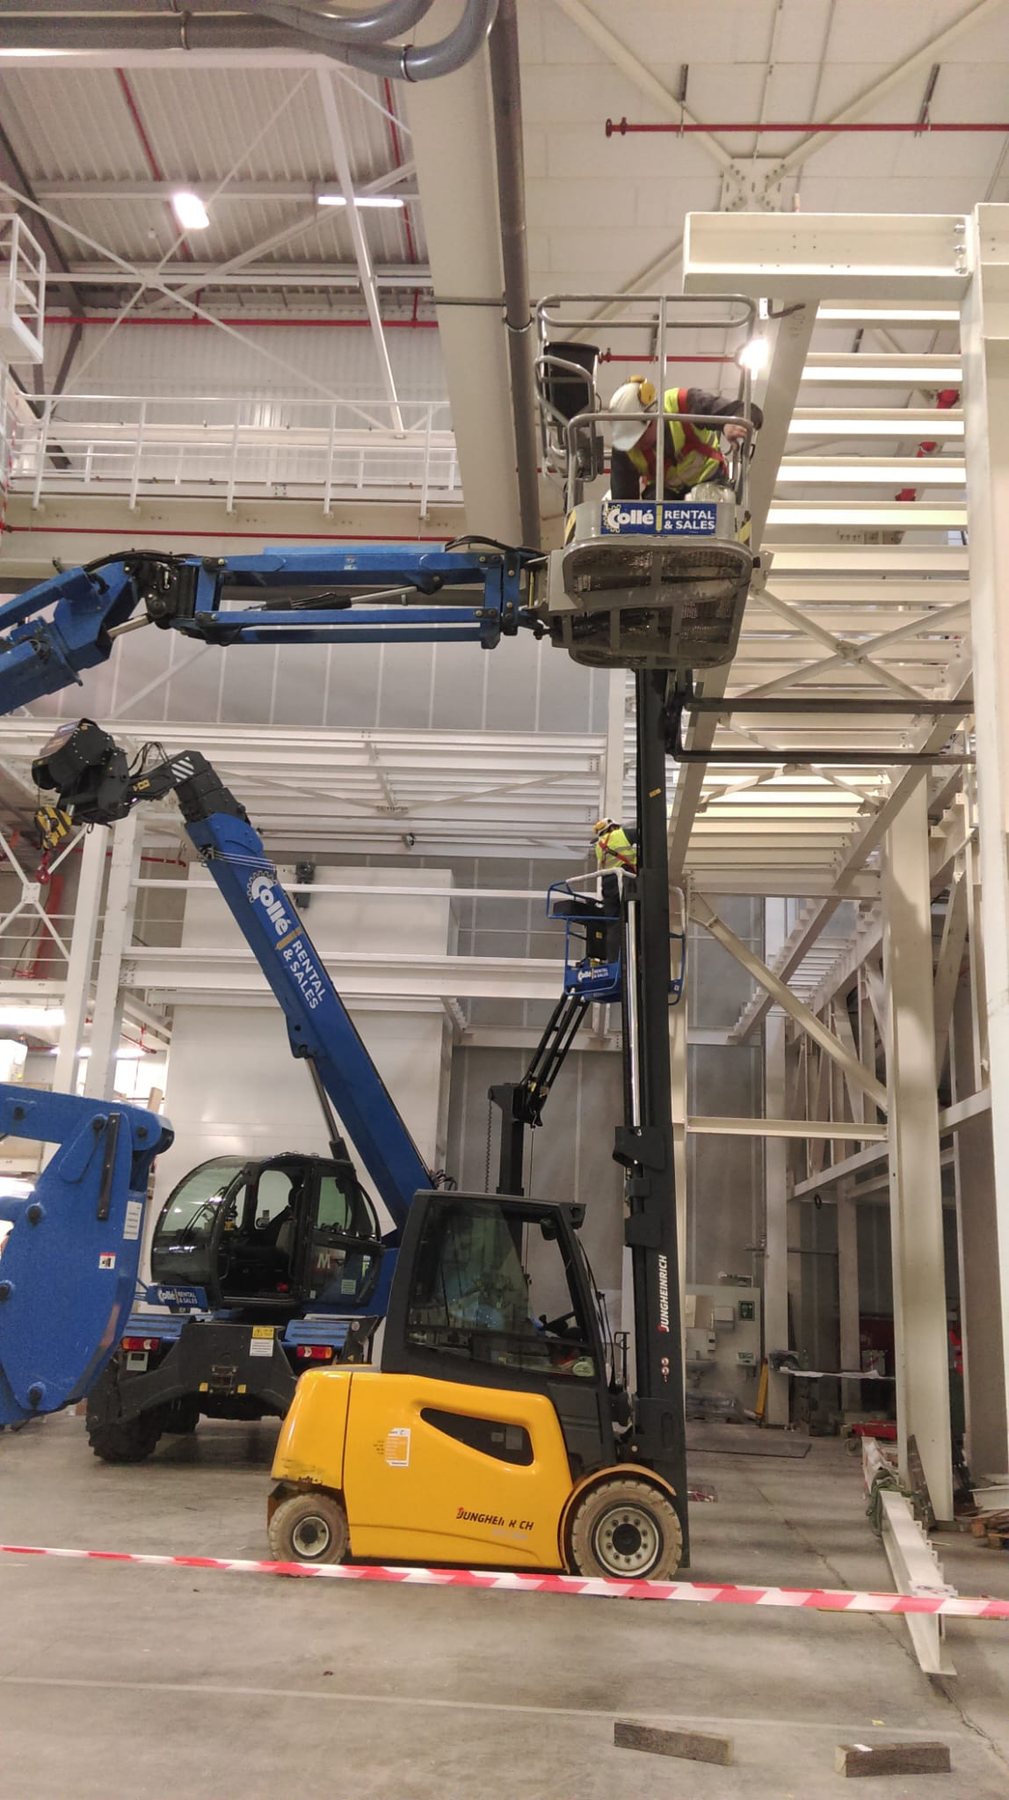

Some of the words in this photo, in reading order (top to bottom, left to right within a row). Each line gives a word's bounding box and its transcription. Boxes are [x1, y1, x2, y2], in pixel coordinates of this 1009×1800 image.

[604, 506, 654, 531] Collé
[664, 510, 715, 520] RENTAL
[676, 521, 715, 530] SALES
[250, 874, 292, 936] Collé
[283, 949, 294, 961] &
[290, 962, 319, 1009] SALES
[292, 940, 326, 1002] RENTAL
[658, 1255, 669, 1332] JUNGHEINRICH
